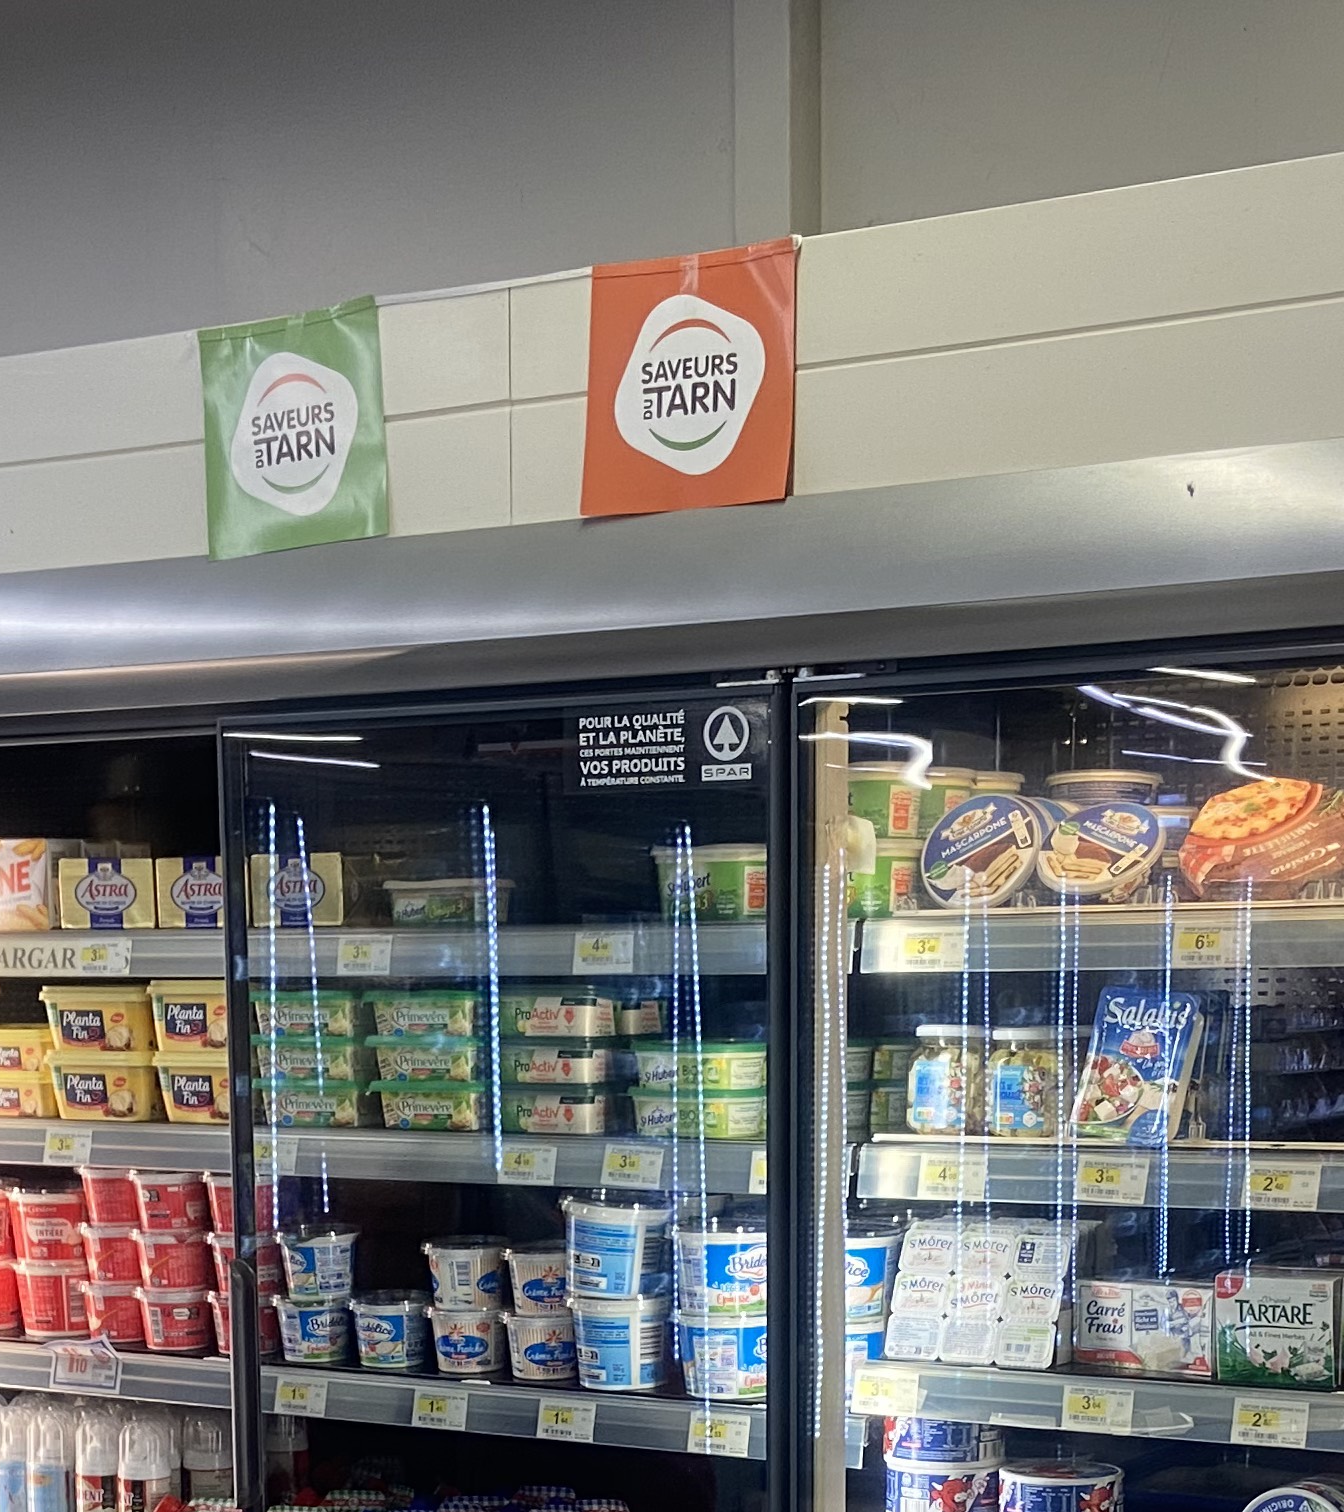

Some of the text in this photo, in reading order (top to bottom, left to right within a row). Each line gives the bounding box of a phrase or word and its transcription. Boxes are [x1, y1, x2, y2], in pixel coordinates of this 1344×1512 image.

[641, 353, 737, 384] SAVEURS
[642, 378, 736, 420] DU TARN
[252, 402, 334, 436] SAVEURS
[264, 425, 335, 463] TARN
[579, 709, 684, 729] POUR LA QUALITÉ
[579, 727, 685, 746] ET LA PLANÈTE,
[580, 749, 593, 757] CES
[580, 756, 685, 774] VOS PRODUITS
[704, 766, 750, 778] SPAR
[940, 817, 1006, 859] MASCARPONE
[1083, 820, 1137, 848] MASCARPONE
[64, 1012, 100, 1027] Planta
[167, 1004, 203, 1020] Planta
[72, 1026, 88, 1040] Fin
[175, 1019, 192, 1033] Fin
[67, 1075, 104, 1092] Planta
[174, 1077, 210, 1093] Planta
[76, 1090, 92, 1103] Fin
[1086, 1301, 1126, 1318] Carré
[1235, 1299, 1314, 1326] TARTARE
[1085, 1315, 1124, 1335] Frais
